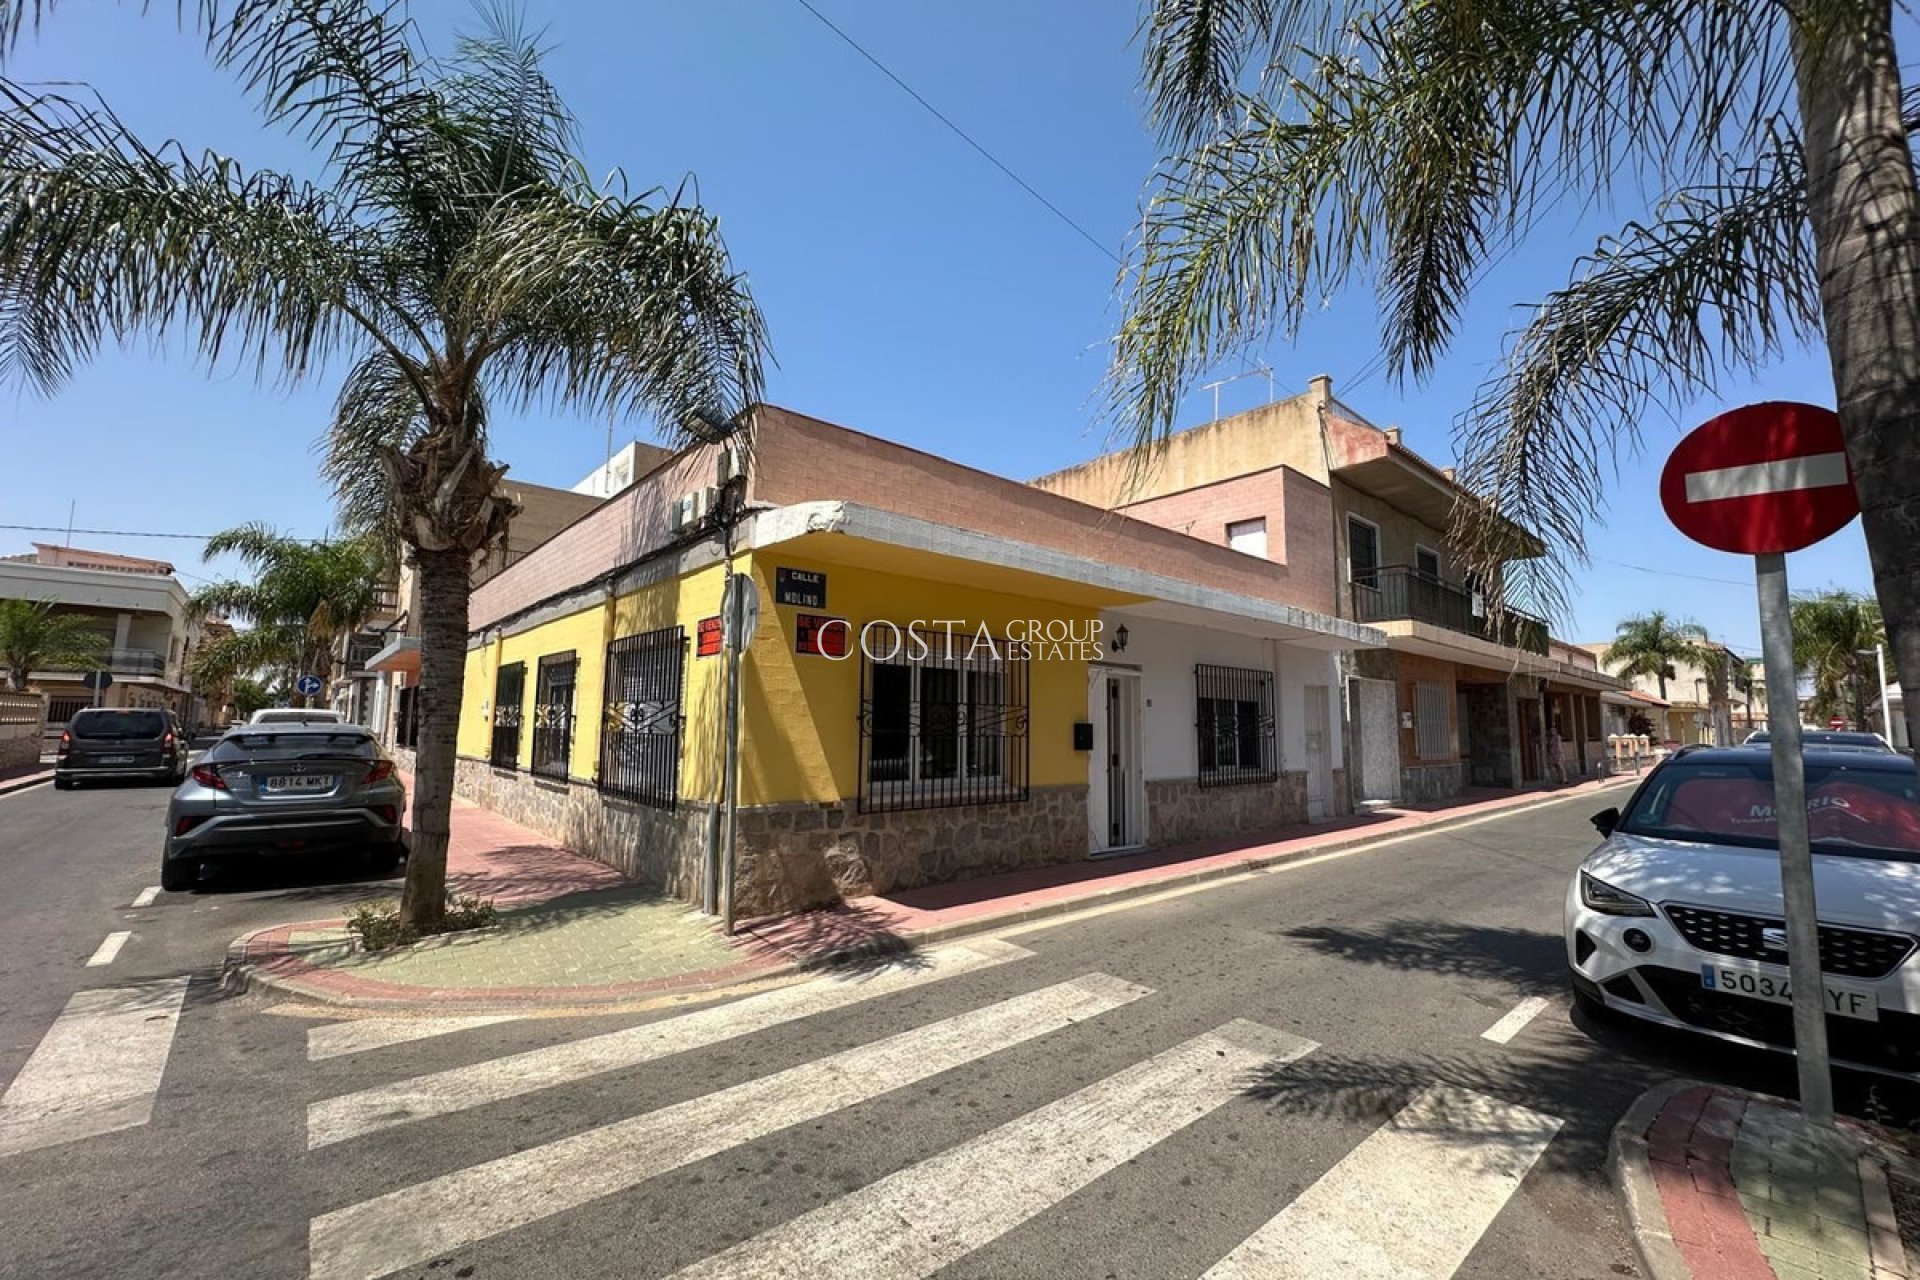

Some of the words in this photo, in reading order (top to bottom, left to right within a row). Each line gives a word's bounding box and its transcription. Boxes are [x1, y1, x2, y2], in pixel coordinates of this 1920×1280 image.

[791, 571, 820, 583] CALLE
[784, 591, 818, 607] MOLINO
[1720, 970, 1793, 1002] 5034
